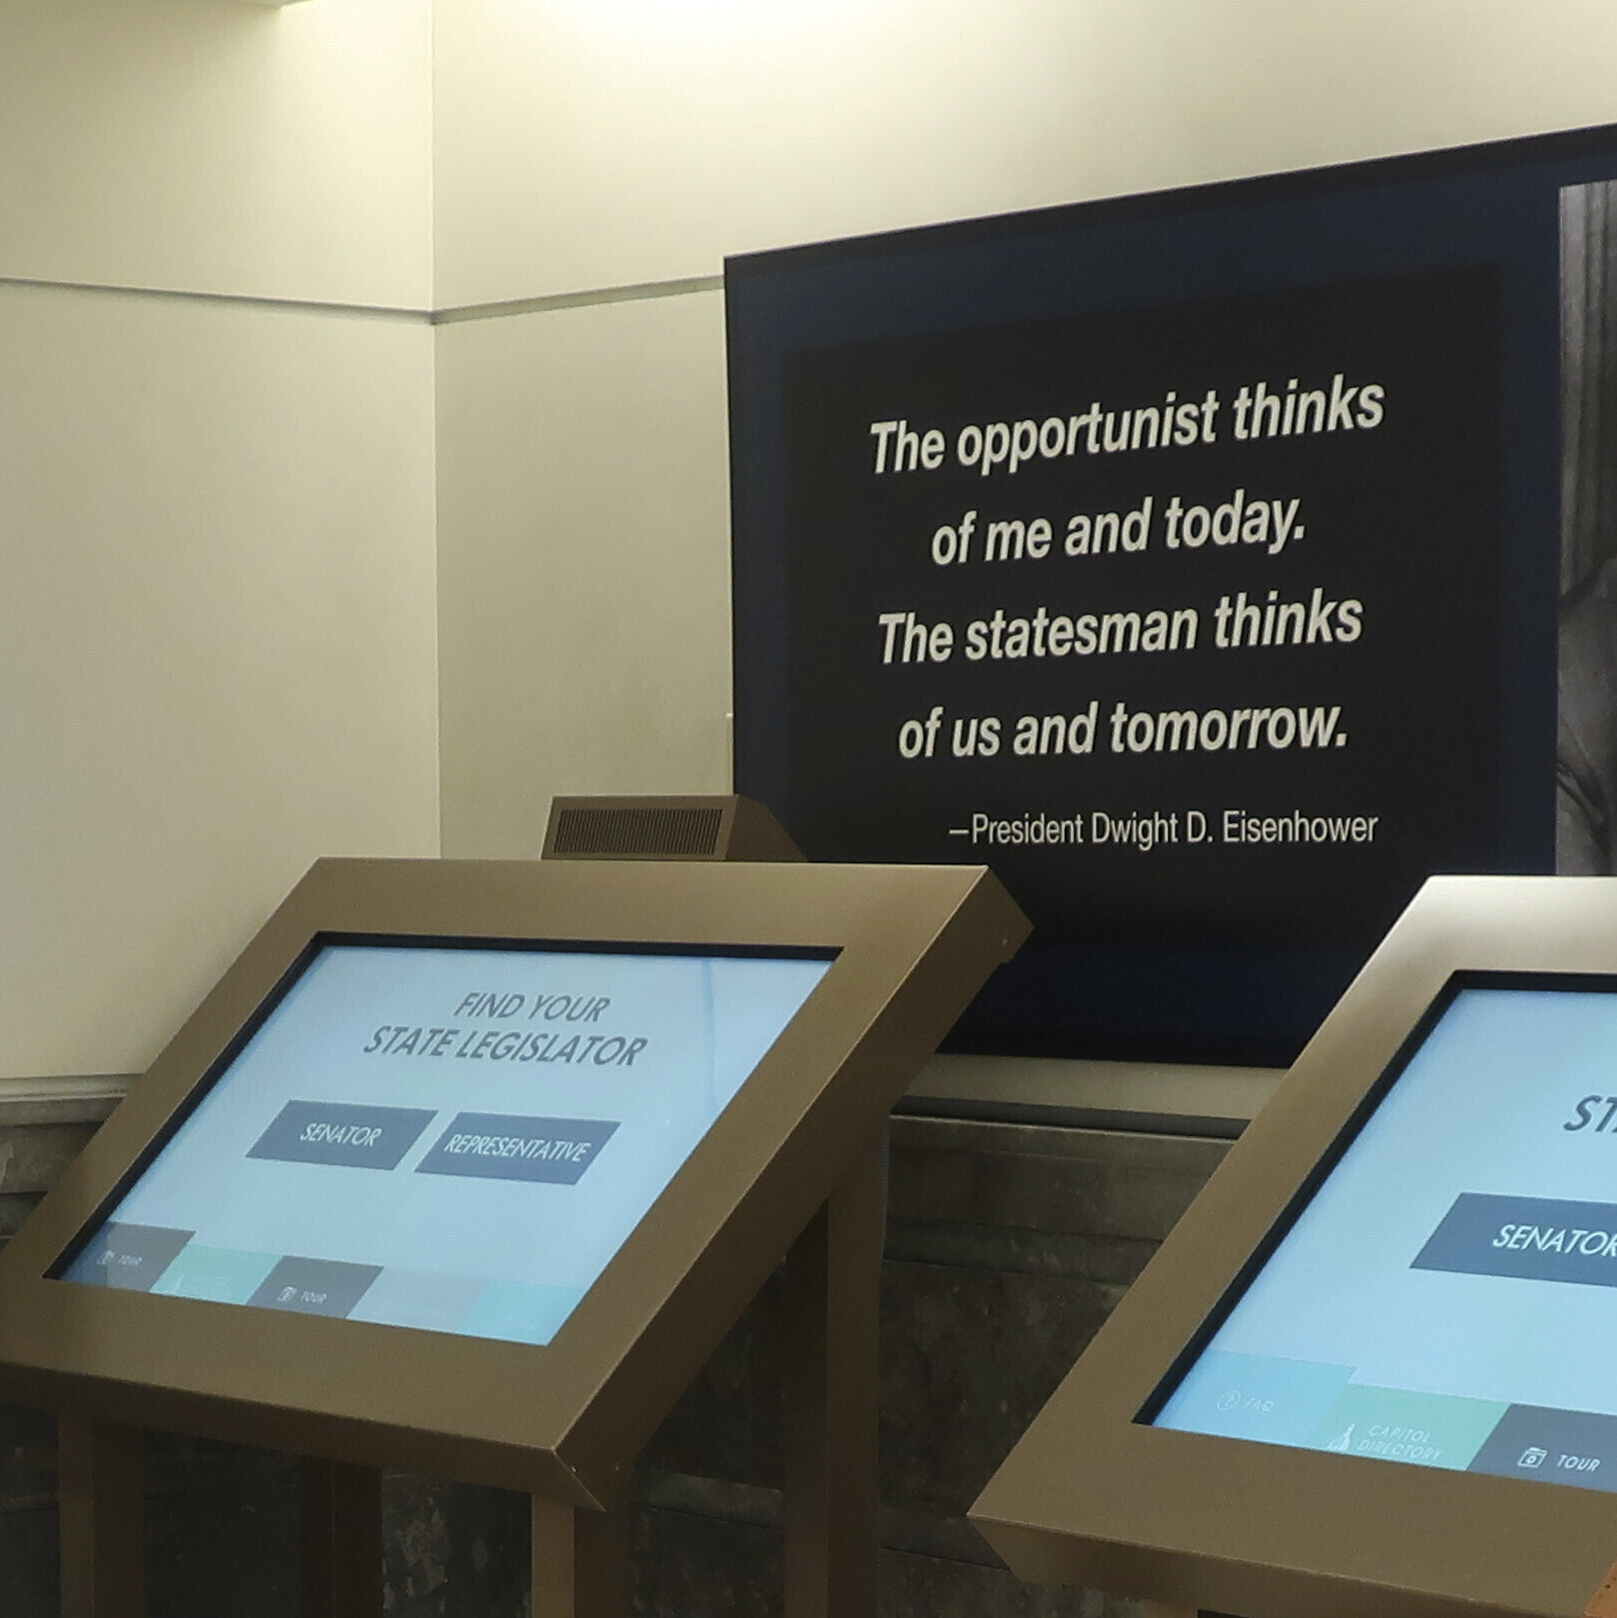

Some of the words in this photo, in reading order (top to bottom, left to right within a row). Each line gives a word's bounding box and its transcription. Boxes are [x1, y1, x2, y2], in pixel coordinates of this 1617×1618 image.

[870, 420, 945, 474] The
[956, 389, 1219, 477] opportunist
[1233, 373, 1385, 441] thinks
[931, 510, 977, 566] of
[984, 517, 1051, 561] me
[1064, 497, 1152, 557] and
[1165, 488, 1306, 554] today.
[878, 611, 954, 664] The
[964, 605, 1198, 661] statesman
[1214, 588, 1363, 648] thinks
[898, 707, 943, 758] of
[951, 714, 1001, 757] us
[1012, 701, 1098, 755] and
[1110, 705, 1348, 753] tomorrow.
[1091, 811, 1179, 852] Dwight
[1187, 812, 1215, 843] D.
[1223, 810, 1379, 843] Eisenhower
[454, 991, 526, 1021] FIND
[533, 994, 611, 1024] YOUR
[363, 1025, 461, 1058] STATE
[455, 1029, 648, 1068] LEGISLATOR
[299, 1122, 382, 1148] SENATOR
[443, 1133, 591, 1164] REPRESENTATIVE
[300, 1291, 327, 1305] TOUR
[1357, 1439, 1444, 1461] DIRECTORY
[1367, 1424, 1432, 1444] CAPITOL
[1557, 1454, 1602, 1473] TOUR
